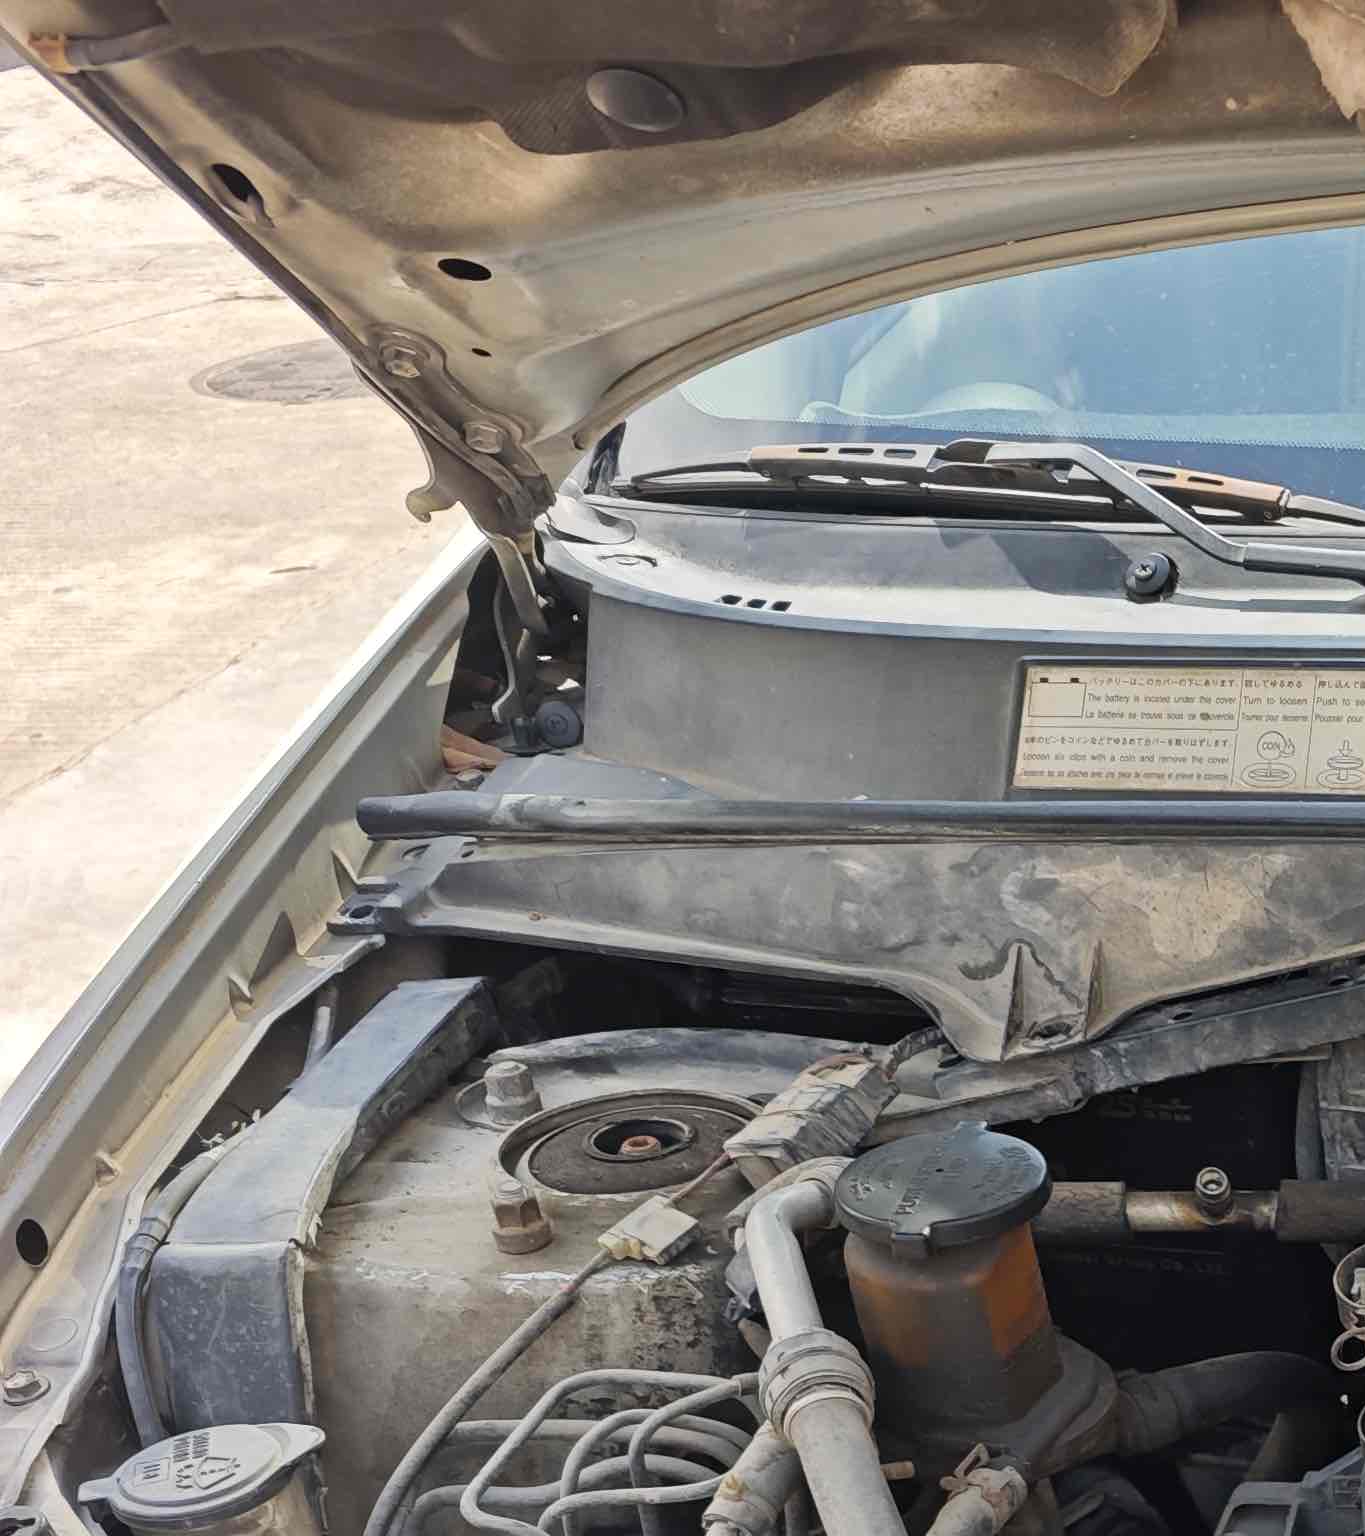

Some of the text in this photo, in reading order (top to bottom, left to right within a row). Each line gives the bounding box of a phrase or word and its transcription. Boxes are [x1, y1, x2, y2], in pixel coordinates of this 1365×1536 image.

[1243, 695, 1308, 705] Turn to loosen
[1316, 696, 1338, 706] Push
[1342, 698, 1351, 706] to
